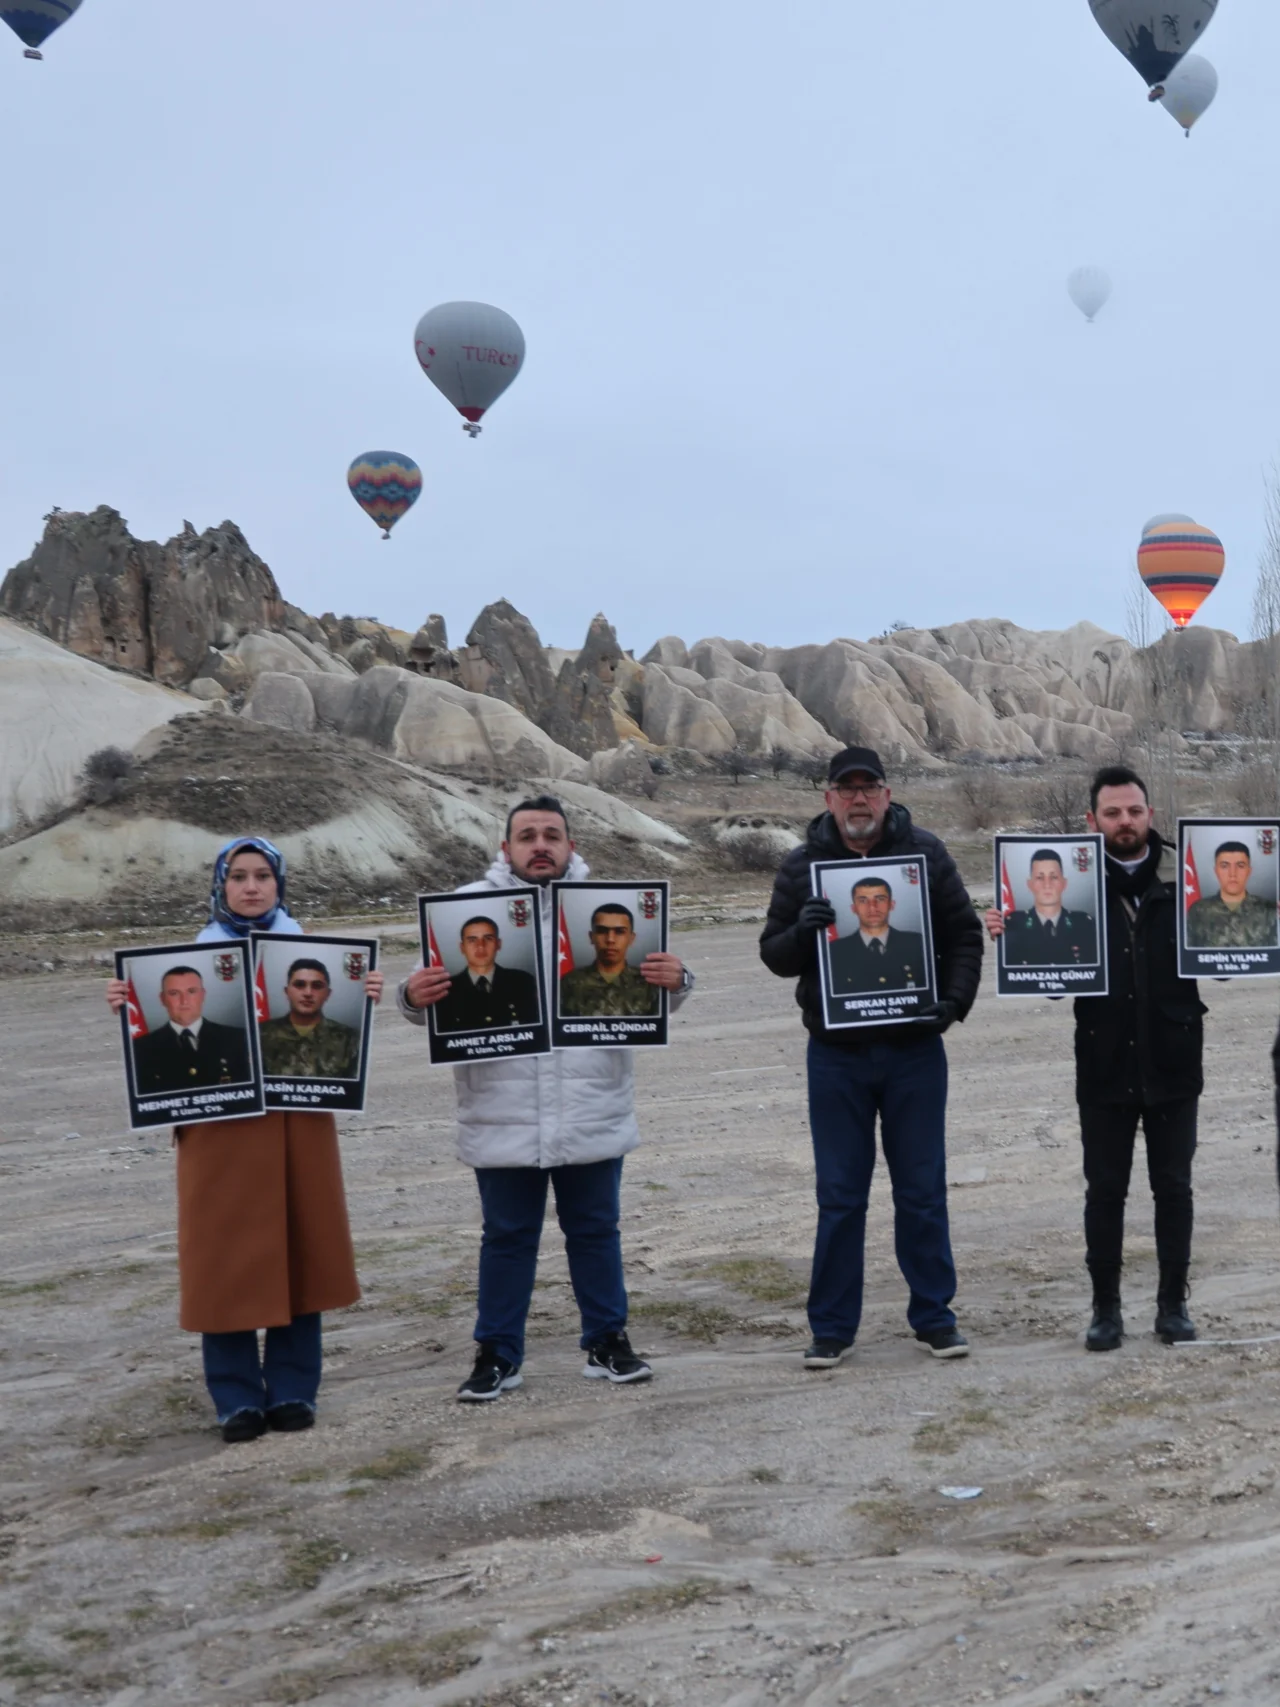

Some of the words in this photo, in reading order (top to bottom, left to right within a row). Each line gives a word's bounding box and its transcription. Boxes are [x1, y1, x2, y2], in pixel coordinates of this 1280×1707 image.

[1230, 953, 1268, 963] YILMAZ
[1007, 972, 1059, 981] RAMAZAN
[1061, 970, 1096, 980] GÜNAY
[844, 998, 887, 1010] SERKAN
[888, 996, 918, 1006] SAYIN
[562, 1022, 609, 1033] CEBRAİL
[611, 1022, 657, 1032] DÜNDAR
[446, 1036, 486, 1048] AHMET
[488, 1032, 533, 1044] ARSLAN
[264, 1081, 294, 1092] ASİN
[296, 1084, 346, 1095] KARACA
[138, 1096, 190, 1113] MEHMET
[192, 1089, 255, 1105] SERİNKAN
